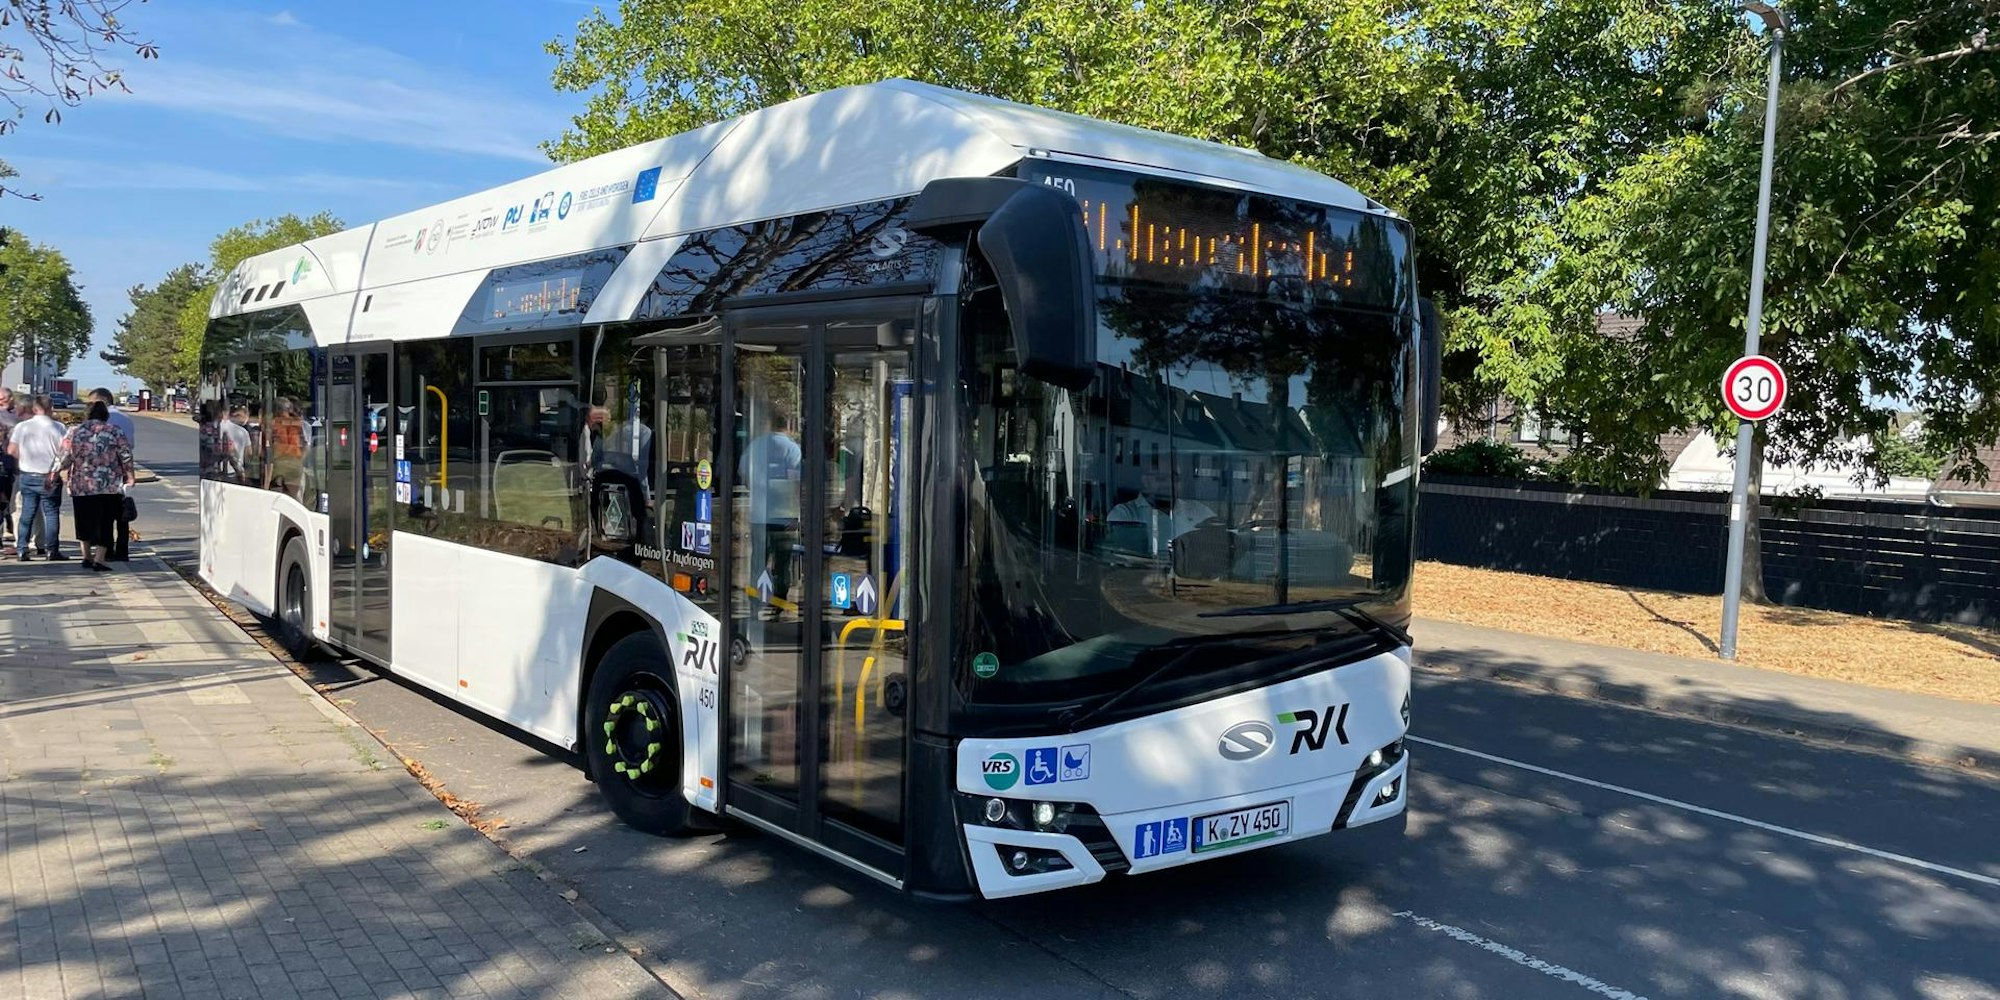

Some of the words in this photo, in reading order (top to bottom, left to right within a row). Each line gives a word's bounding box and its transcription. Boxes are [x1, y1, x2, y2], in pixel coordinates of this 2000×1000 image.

[866, 261, 901, 273] SOLARIS
[1738, 376, 1772, 402] 30
[634, 543, 661, 560] Urbino
[672, 550, 714, 571] hydrogen
[699, 688, 715, 709] 450
[982, 761, 1012, 773] VRS
[1208, 819, 1219, 842] K
[1230, 813, 1250, 837] ZY
[1253, 808, 1280, 832] 450
